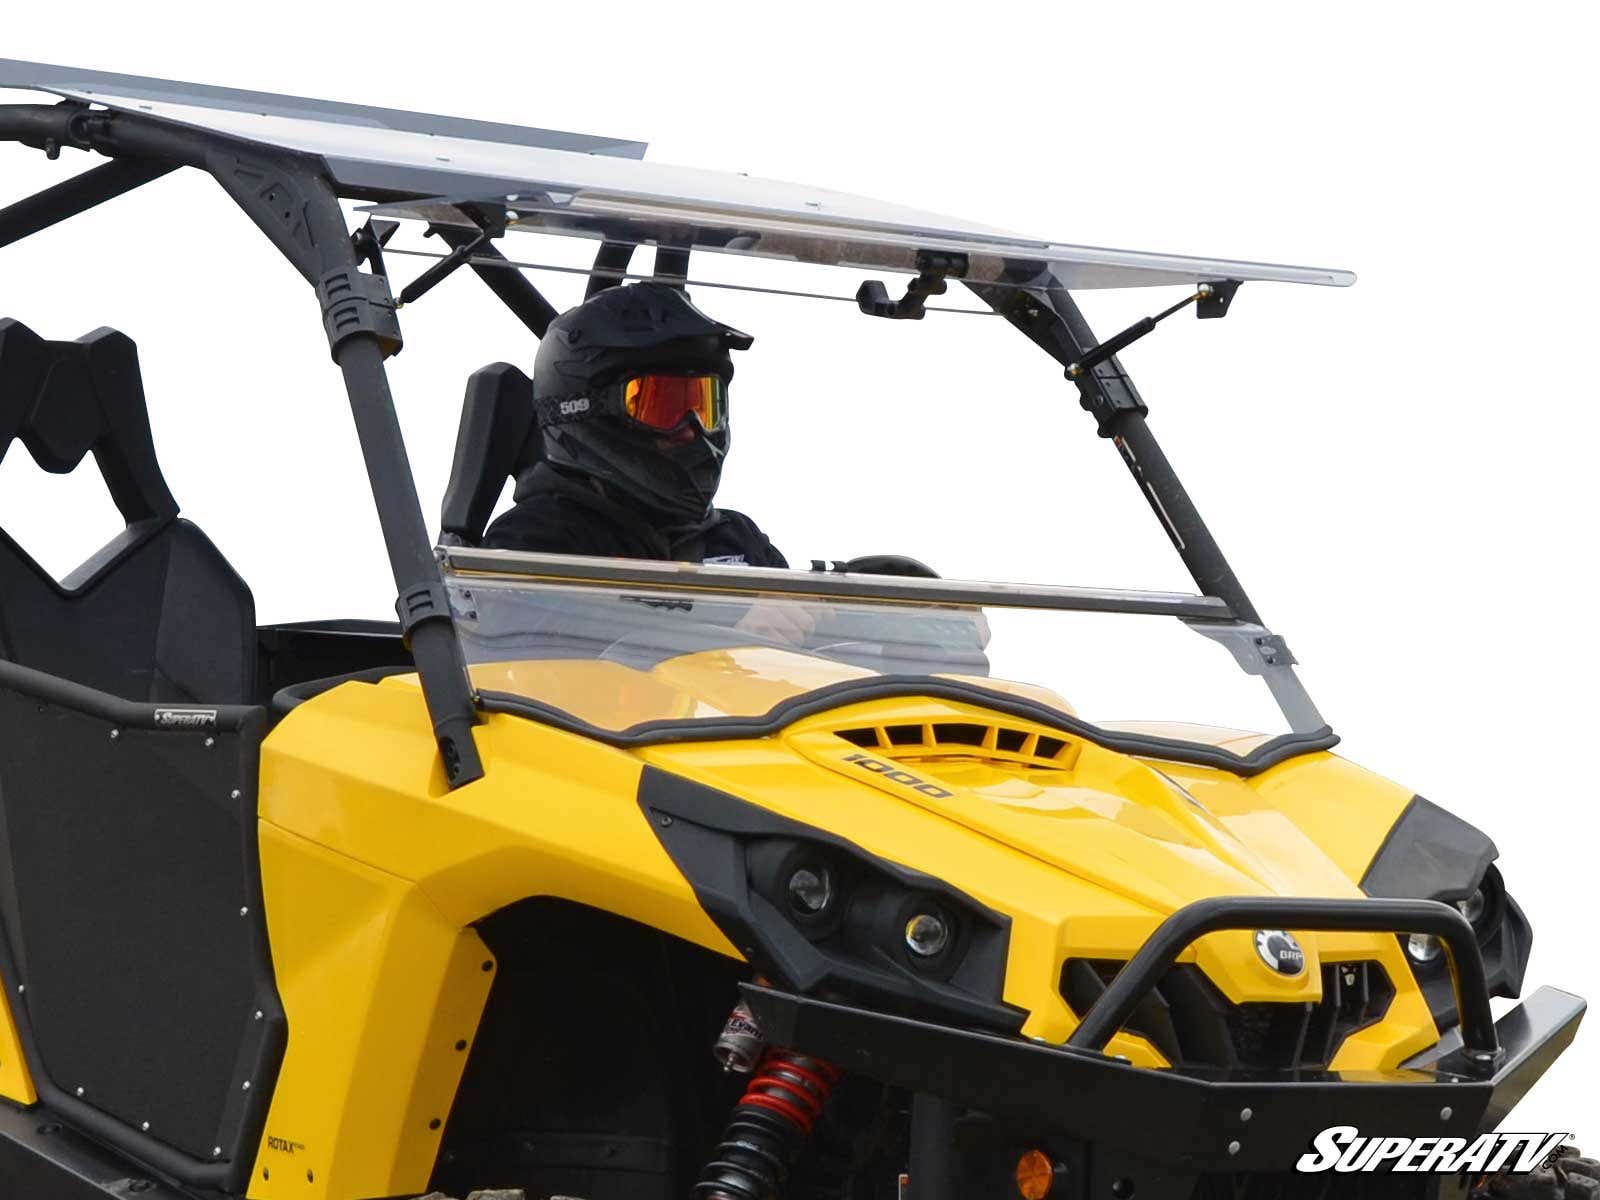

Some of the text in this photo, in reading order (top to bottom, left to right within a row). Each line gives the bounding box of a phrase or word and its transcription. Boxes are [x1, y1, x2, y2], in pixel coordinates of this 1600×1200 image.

[559, 398, 590, 415] 509
[842, 753, 954, 798] 1000
[1279, 949, 1304, 960] BRP
[267, 1136, 294, 1154] ROTAX
